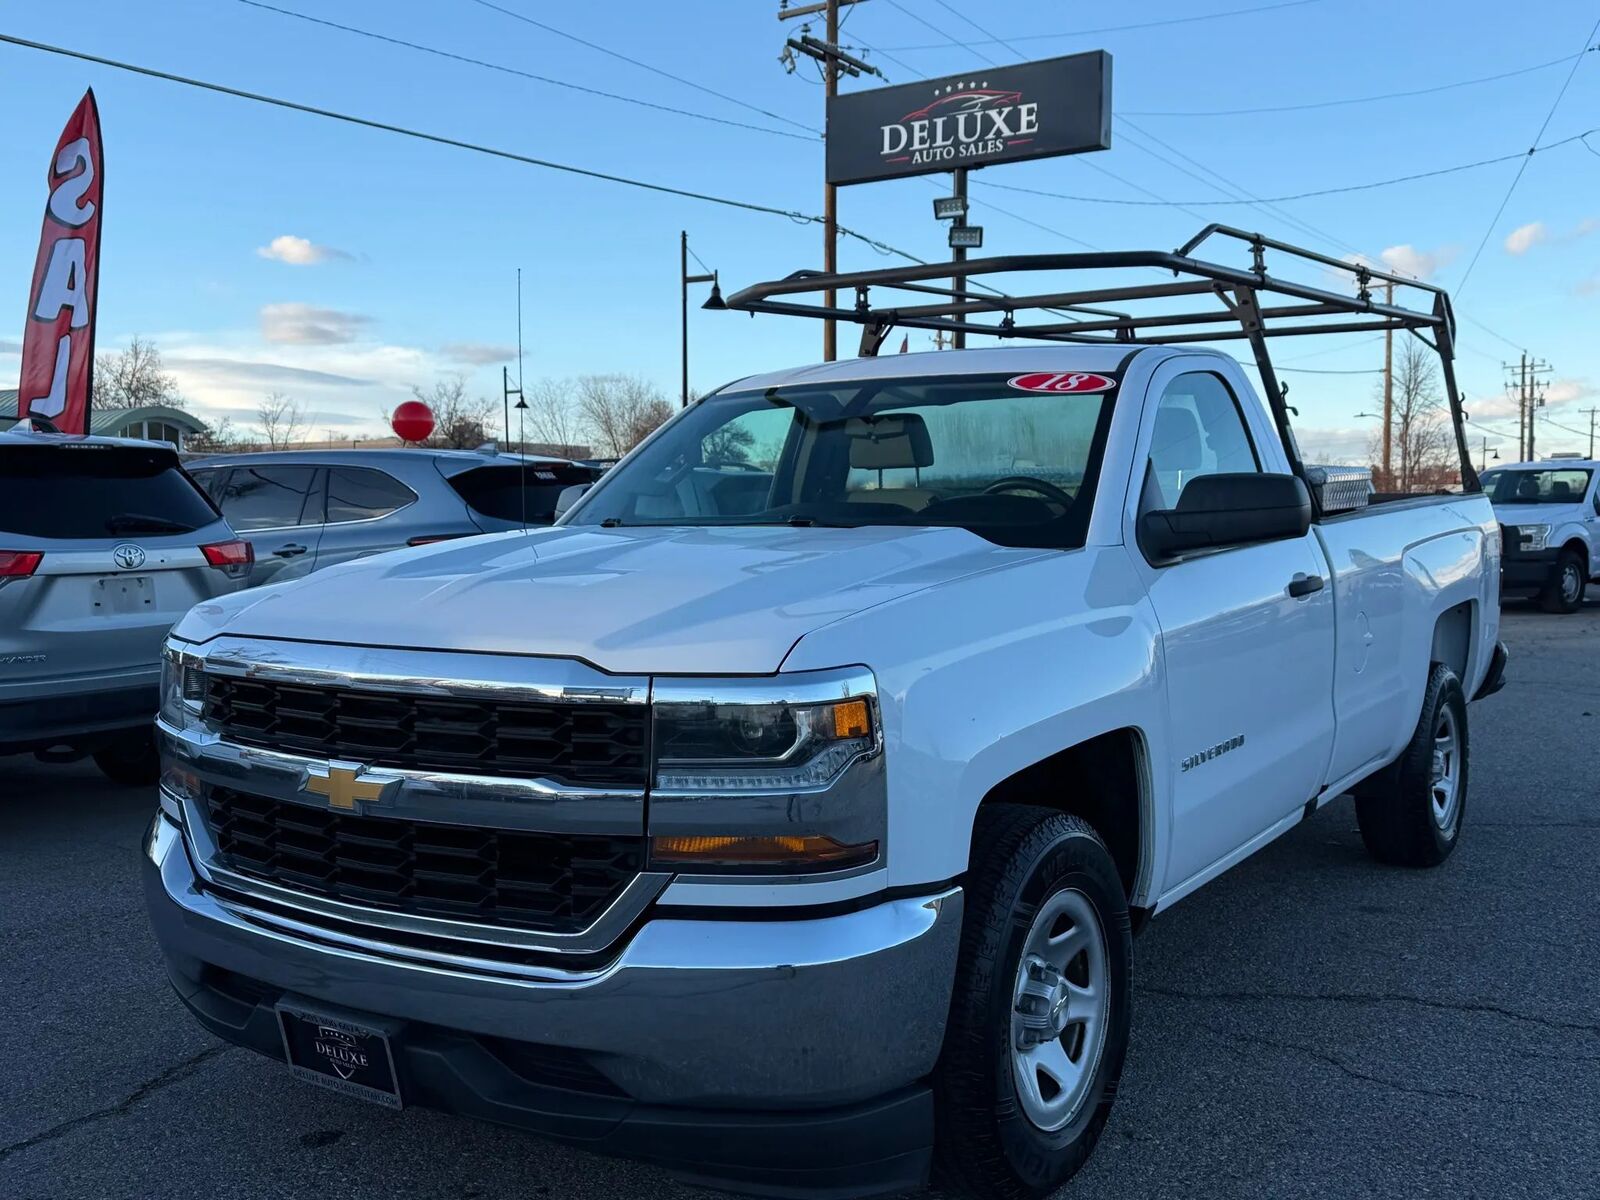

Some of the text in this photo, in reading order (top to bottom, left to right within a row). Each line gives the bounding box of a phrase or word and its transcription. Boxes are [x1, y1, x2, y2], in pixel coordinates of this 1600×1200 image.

[880, 102, 1039, 155] DELUXE
[912, 138, 1004, 165] AUTO SALES
[315, 1041, 369, 1067] DELUXE
